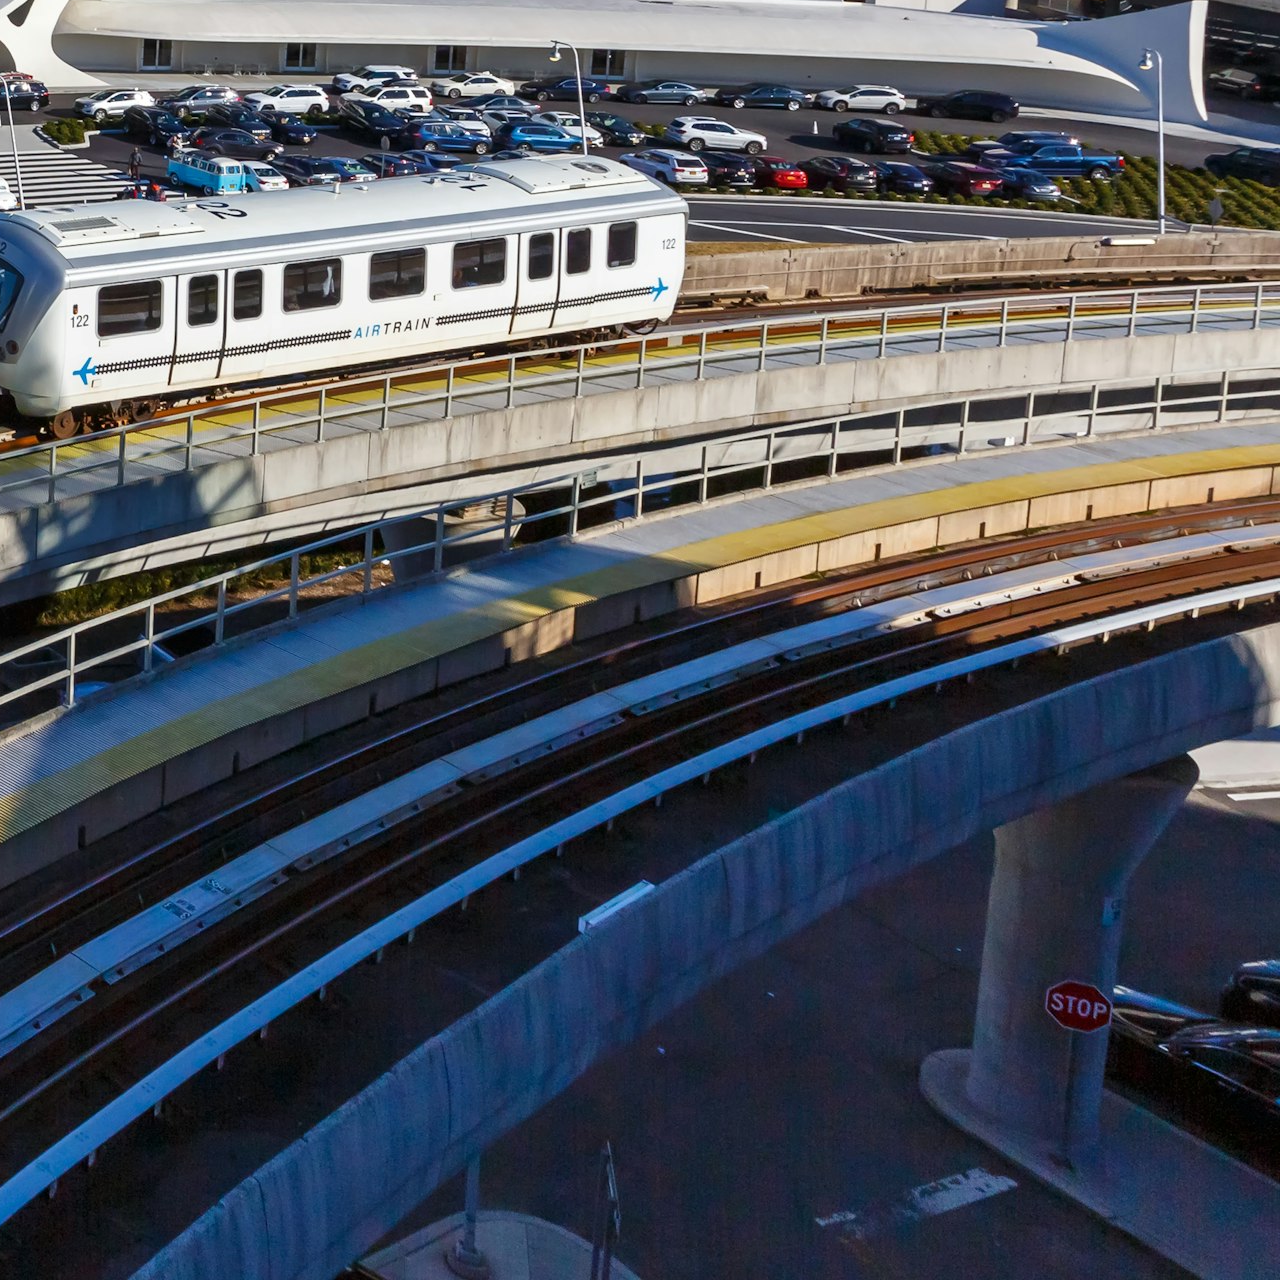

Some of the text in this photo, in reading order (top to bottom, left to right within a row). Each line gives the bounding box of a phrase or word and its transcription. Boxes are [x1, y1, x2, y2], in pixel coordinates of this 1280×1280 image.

[662, 238, 676, 250] 122
[70, 314, 89, 329] 122
[354, 317, 431, 339] AIRTRAIN
[1051, 992, 1107, 1019] STOP
